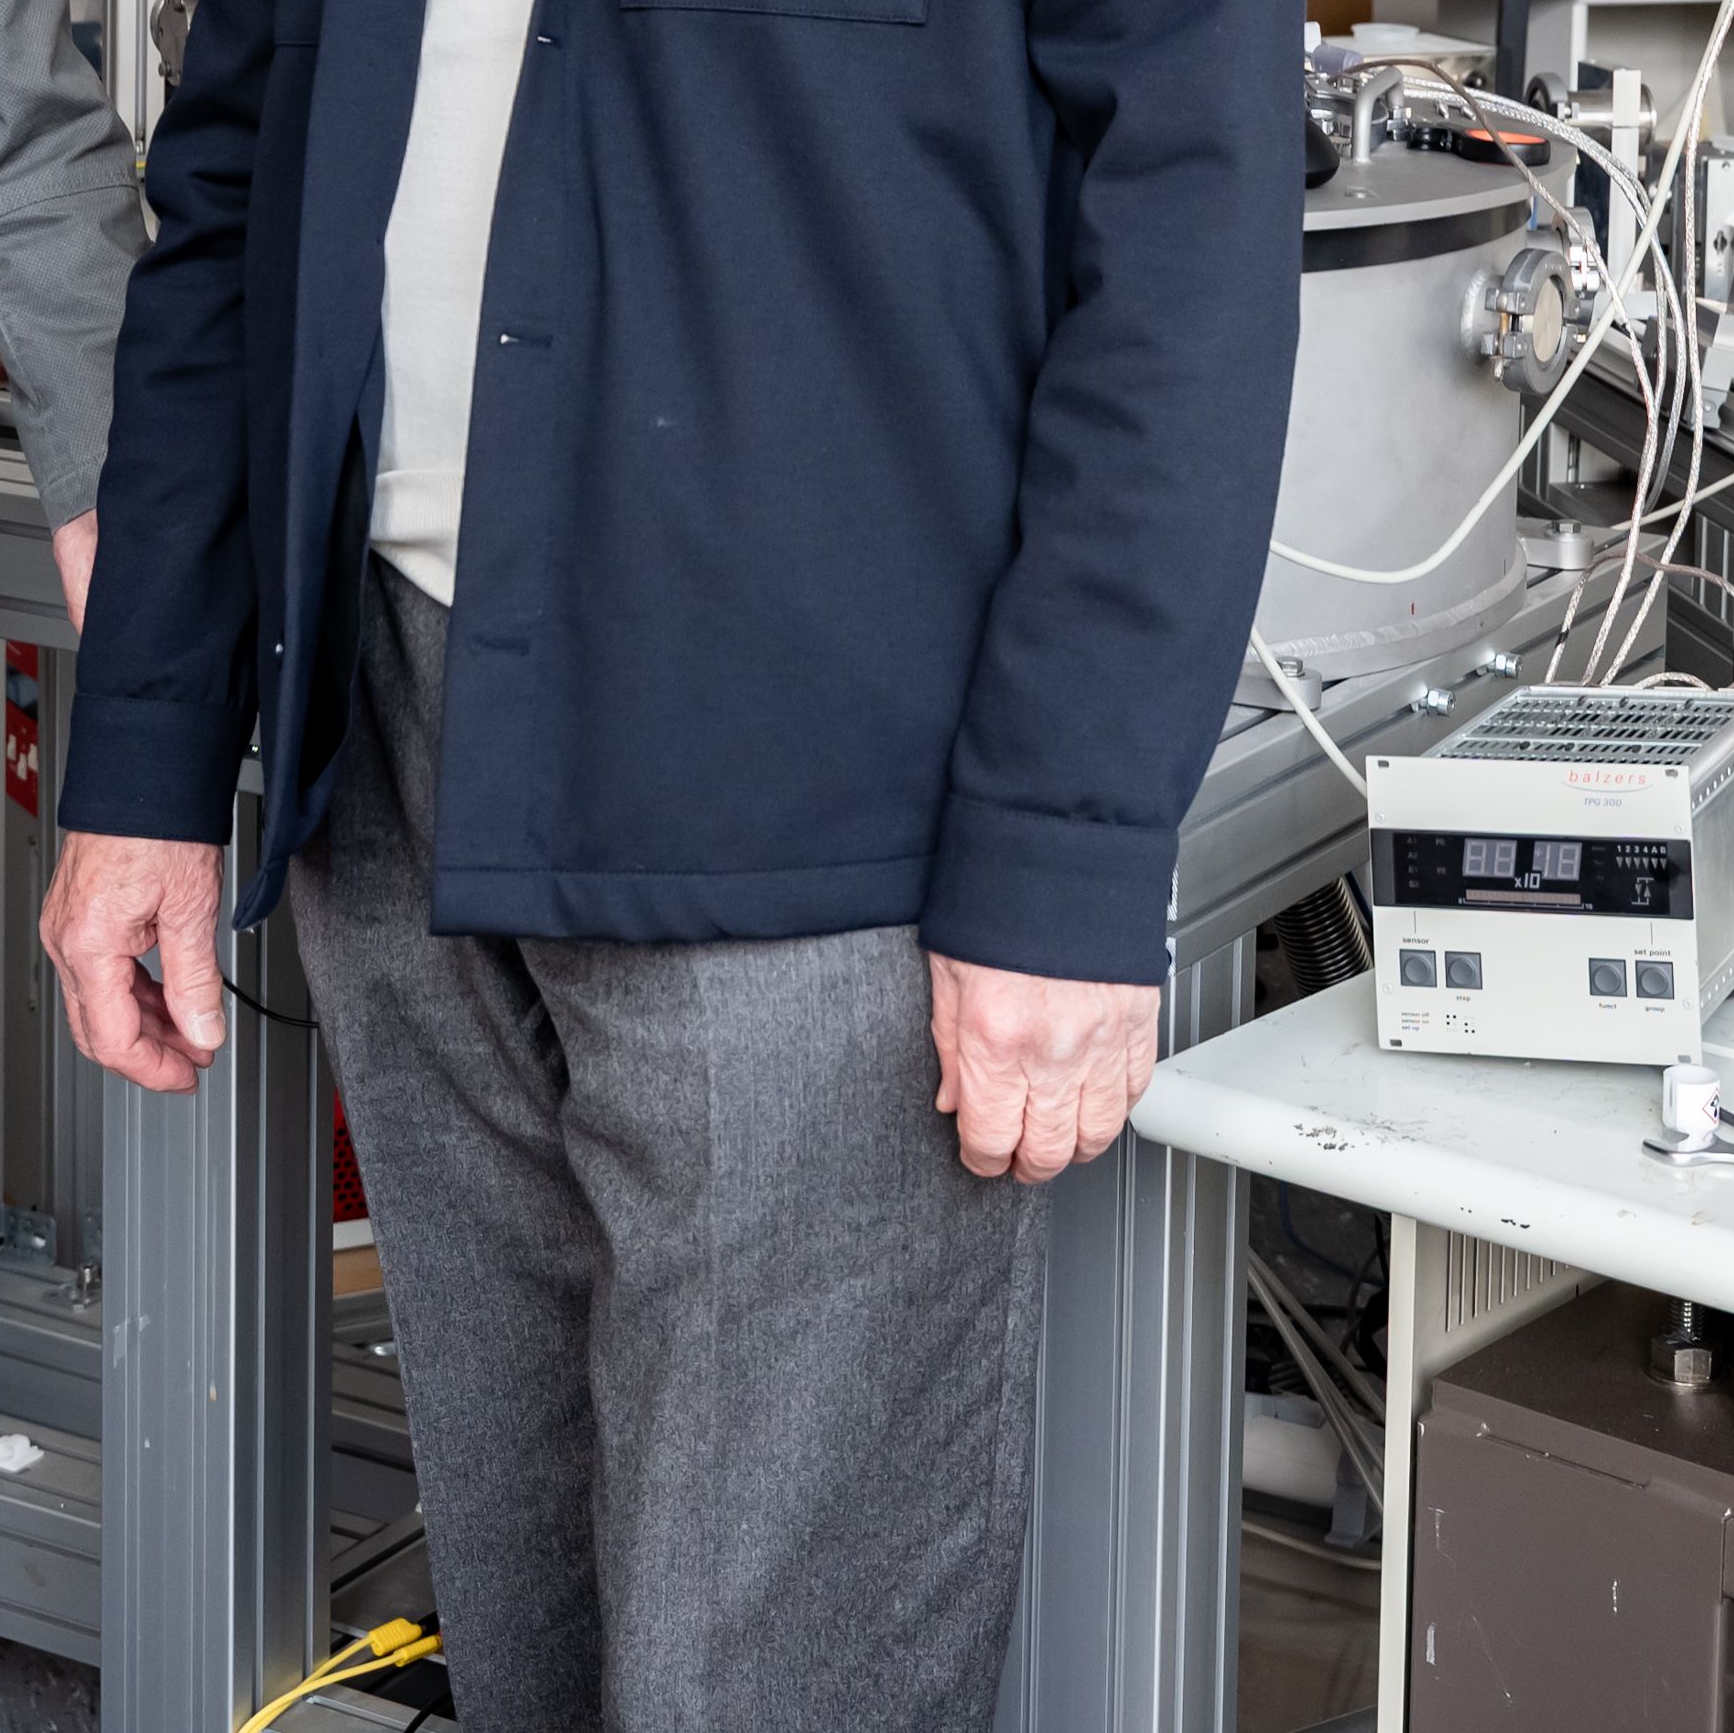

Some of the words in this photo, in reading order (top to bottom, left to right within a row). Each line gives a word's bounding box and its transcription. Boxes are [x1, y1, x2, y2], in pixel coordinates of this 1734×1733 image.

[1569, 769, 1646, 785] balzers
[1584, 797, 1601, 807] TPG
[1603, 797, 1623, 808] 300
[1514, 872, 1541, 888] x10
[1402, 937, 1429, 945] sensor
